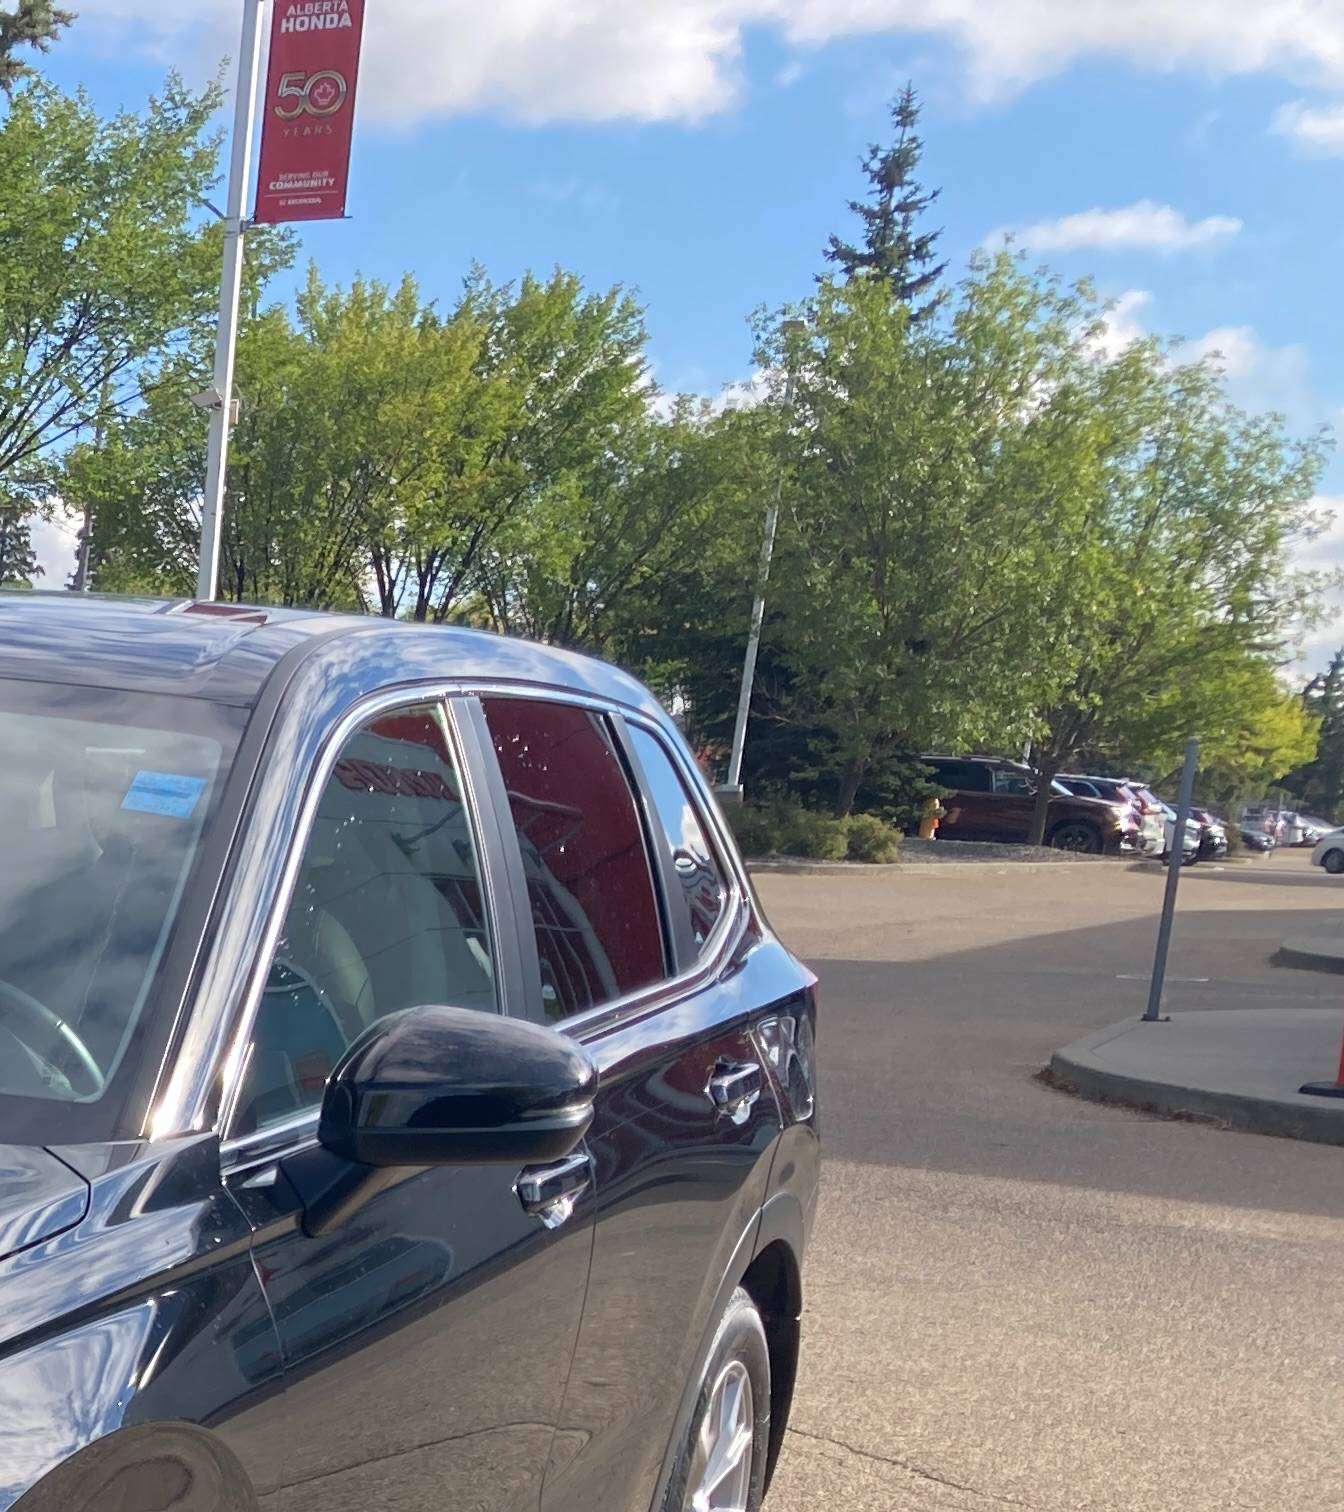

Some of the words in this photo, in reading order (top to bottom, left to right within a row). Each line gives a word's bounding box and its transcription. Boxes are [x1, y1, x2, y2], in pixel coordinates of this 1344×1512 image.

[287, 0, 348, 16] ALBERTA
[280, 13, 352, 33] HONDA
[274, 70, 346, 120] 50
[282, 124, 332, 137] YEARS
[269, 178, 334, 190] COMMUNITY
